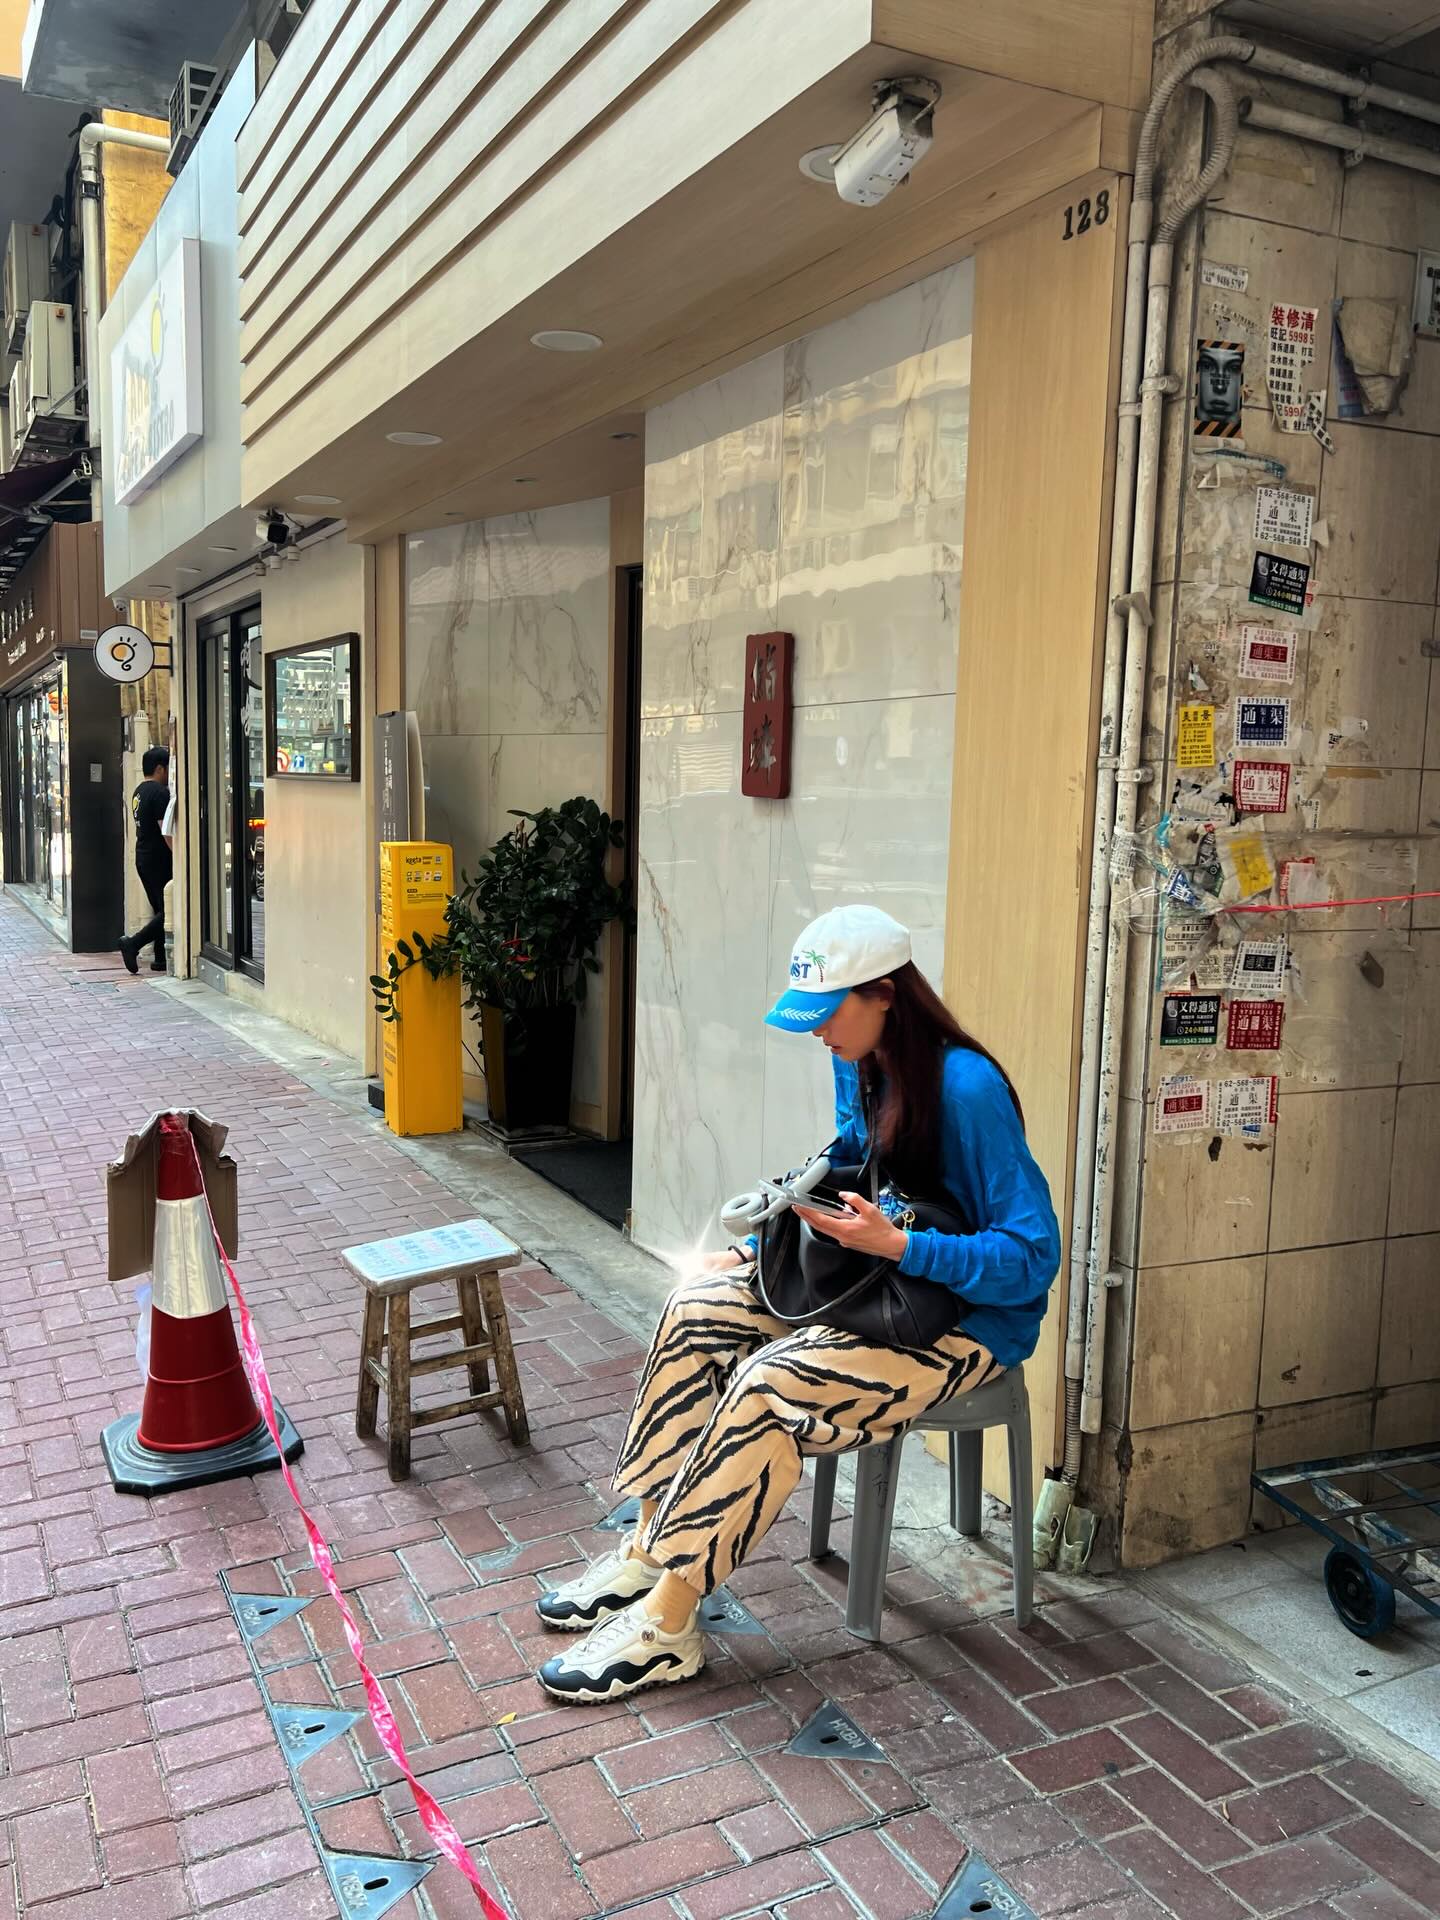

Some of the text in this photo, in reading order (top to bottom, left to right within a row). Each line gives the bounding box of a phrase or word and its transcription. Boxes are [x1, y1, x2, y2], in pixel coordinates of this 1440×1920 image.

[1062, 189, 1110, 240] 128
[1289, 330, 1307, 343] 5998
[1264, 489, 1306, 503] 62-568-568
[1260, 532, 1301, 545] 62-568-568
[1269, 561, 1307, 582] 又得通渠
[1251, 644, 1286, 661] 通渠王
[1179, 1000, 1218, 1013] 又得通渠
[1224, 1078, 1265, 1087] 62-568-568
[1166, 1097, 1201, 1113] 通渠王
[1222, 1117, 1262, 1127] 62-568-568
[828, 1717, 868, 1749] HKBN
[978, 1879, 1027, 1920] HKBN
